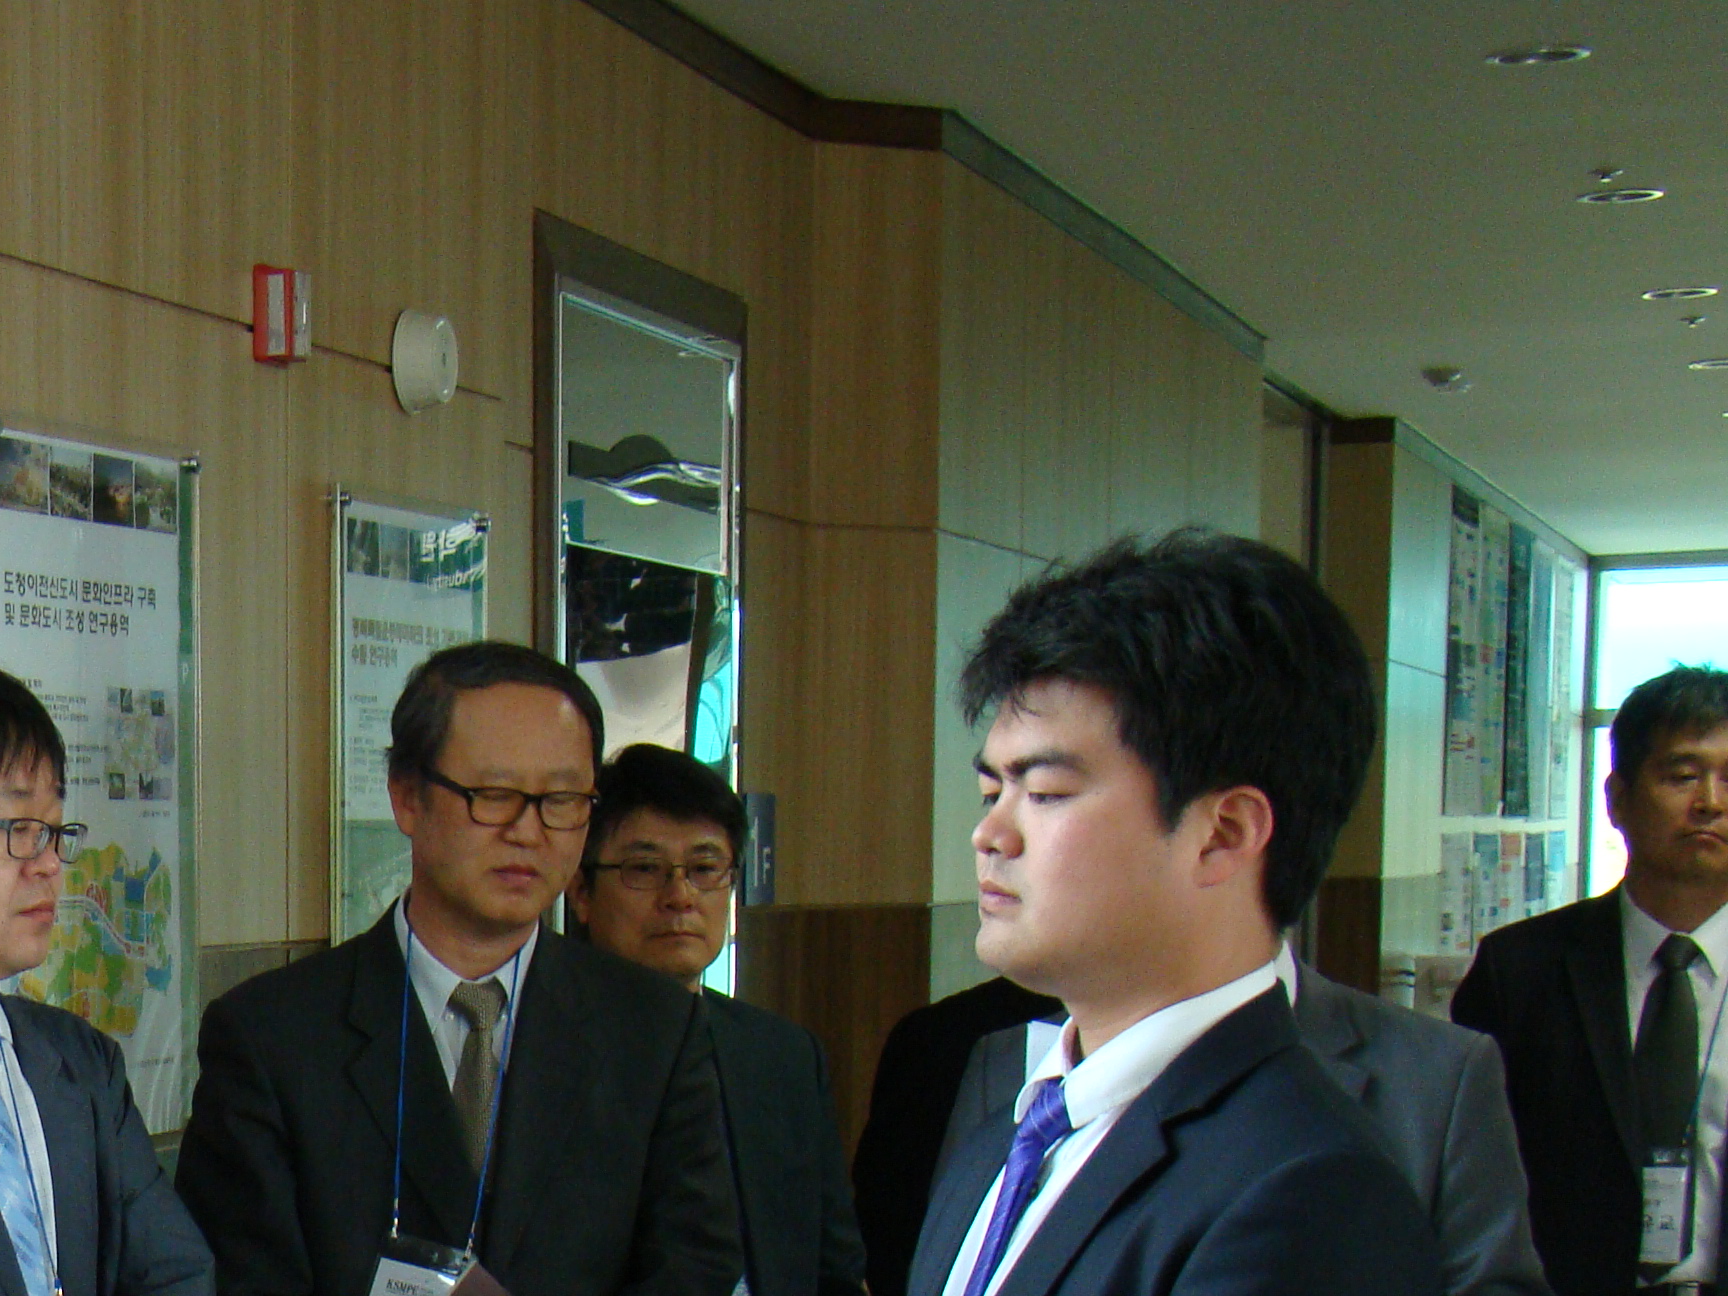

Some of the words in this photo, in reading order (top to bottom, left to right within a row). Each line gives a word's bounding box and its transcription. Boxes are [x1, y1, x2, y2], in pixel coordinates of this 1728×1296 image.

[4, 571, 78, 601] 도청이전신도시
[82, 580, 133, 609] 문화인프라
[137, 586, 156, 610] 구축
[5, 603, 15, 626] 및
[20, 604, 62, 630] 문화도시
[66, 609, 85, 633] 조성
[89, 610, 129, 637] 연구용역
